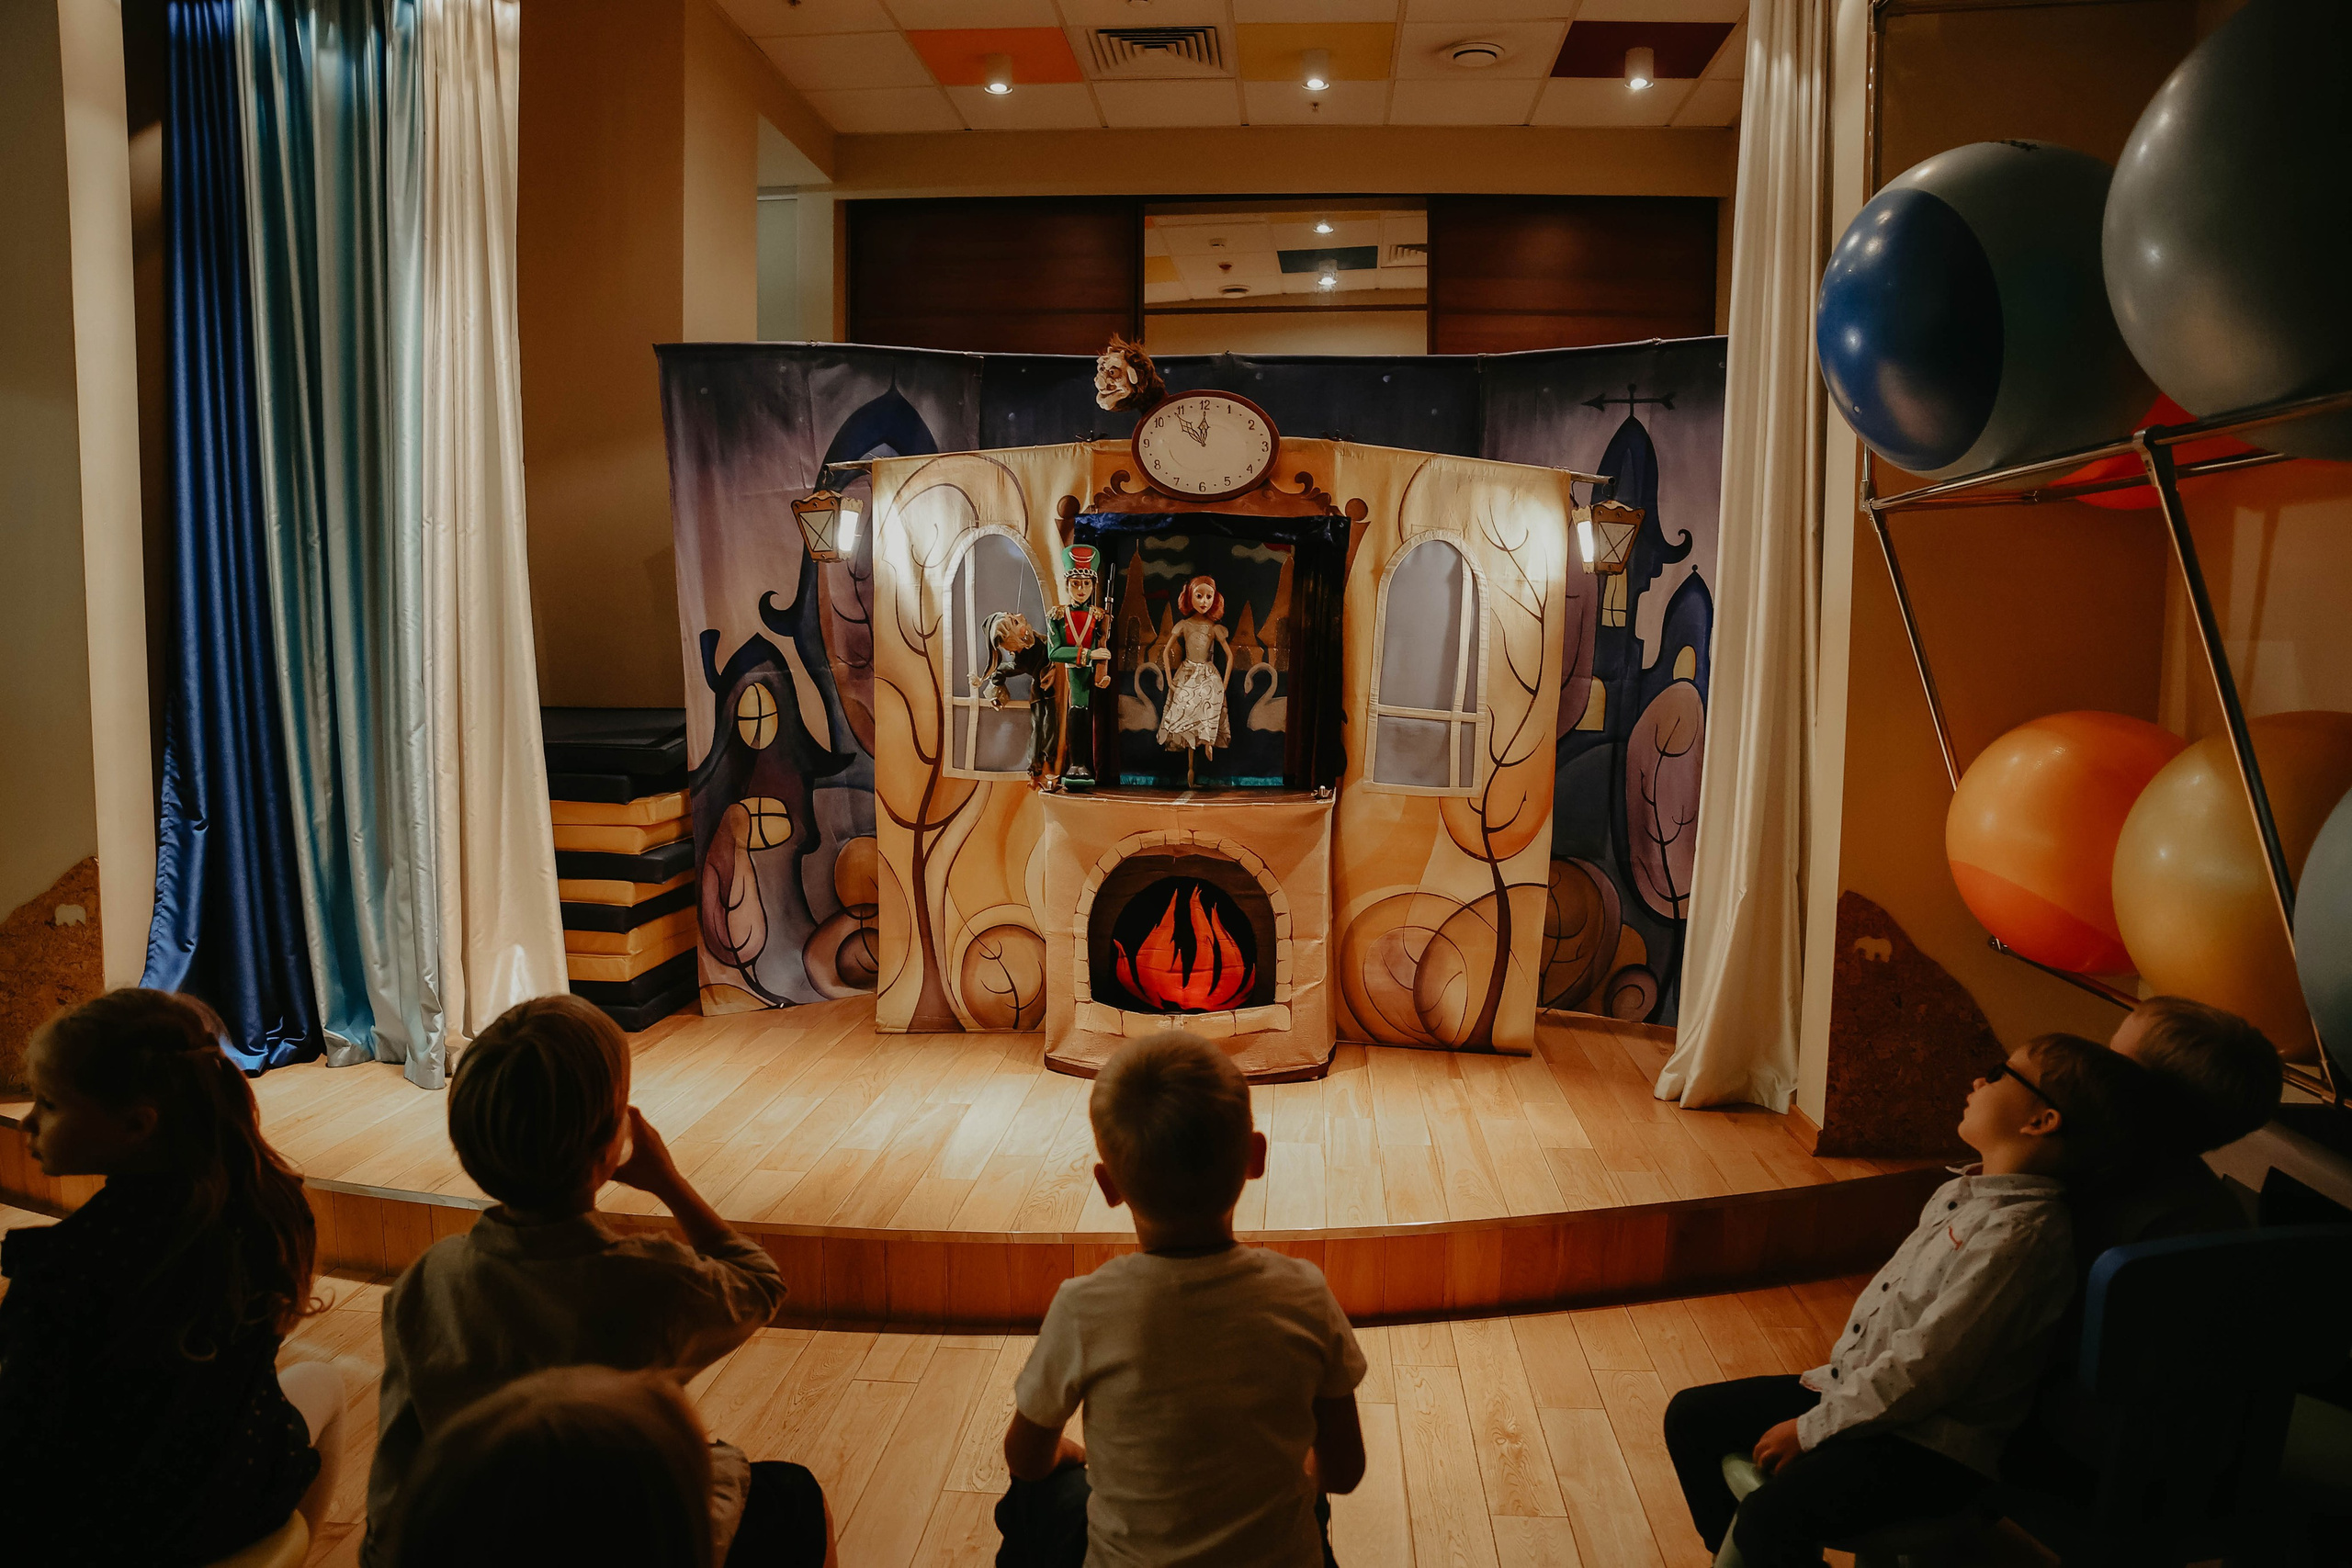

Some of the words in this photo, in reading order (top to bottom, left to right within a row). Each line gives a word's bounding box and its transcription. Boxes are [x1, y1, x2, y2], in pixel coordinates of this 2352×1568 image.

[1177, 405, 1185, 415] 11
[1199, 400, 1211, 411] 12
[1227, 404, 1231, 414] 1
[1154, 417, 1164, 428] 10
[1248, 419, 1256, 431] 2
[1143, 438, 1150, 448] 9
[1261, 441, 1269, 453] 3
[1154, 459, 1161, 470] 8
[1246, 464, 1253, 474] 4
[1173, 477, 1181, 486] 7
[1198, 481, 1206, 492] 6
[1224, 476, 1231, 487] 5
